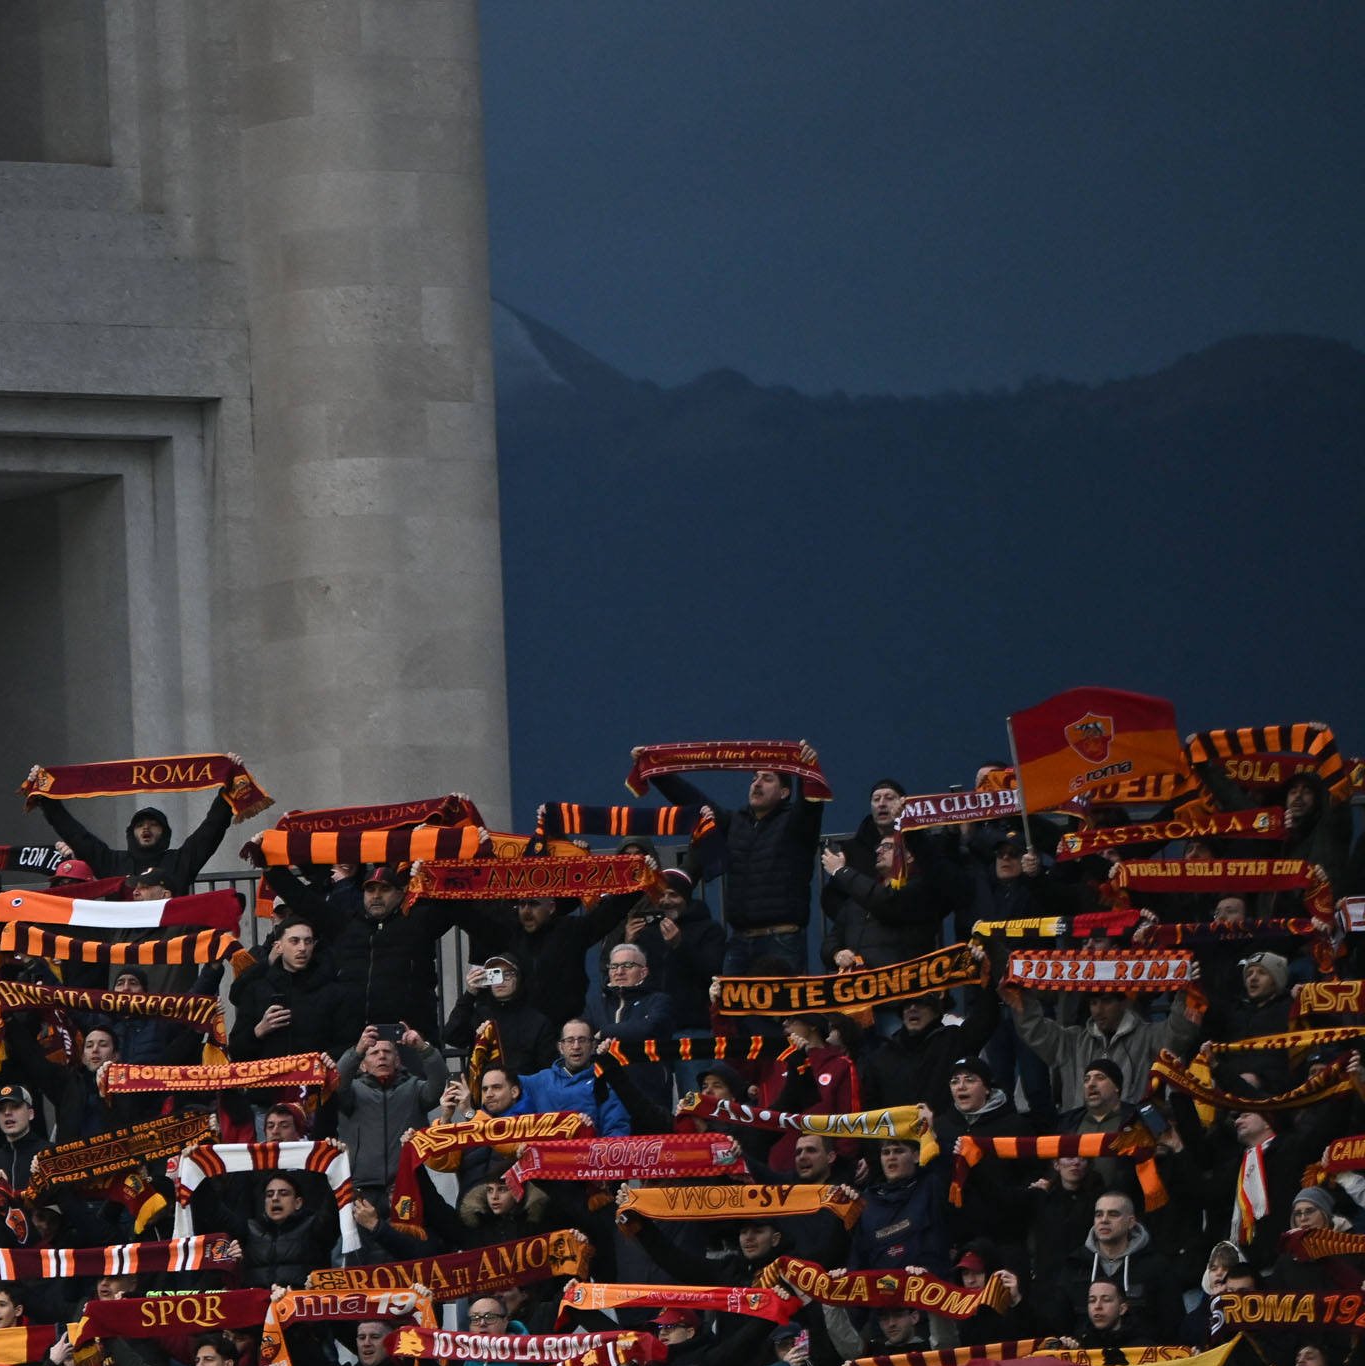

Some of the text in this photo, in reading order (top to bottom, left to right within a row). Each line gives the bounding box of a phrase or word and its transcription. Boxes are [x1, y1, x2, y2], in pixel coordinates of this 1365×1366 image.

[131, 760, 215, 787] ROMA
[1085, 757, 1132, 783] roma
[345, 801, 430, 829] CISALPINA
[939, 793, 988, 817] CLUB
[1142, 813, 1245, 841] ROMA
[19, 847, 46, 867] CON
[1127, 859, 1300, 878] VOGLIO SOLO STAR CON
[1020, 958, 1187, 981] FORZA ROMA
[721, 959, 947, 1010] MO' TE GONFIO
[127, 1055, 310, 1081] ROMA CLUB CASSINO
[90, 1133, 115, 1146] NON
[589, 1139, 664, 1166] ROMA
[41, 1141, 124, 1178] FORZA
[93, 1157, 142, 1177] MAGICA,
[577, 1168, 629, 1177] CAMPIONI
[451, 1239, 549, 1286] TI AMO
[785, 1263, 868, 1302] FORZA
[140, 1293, 225, 1328] SPQR
[457, 1333, 541, 1360] SONO LA
